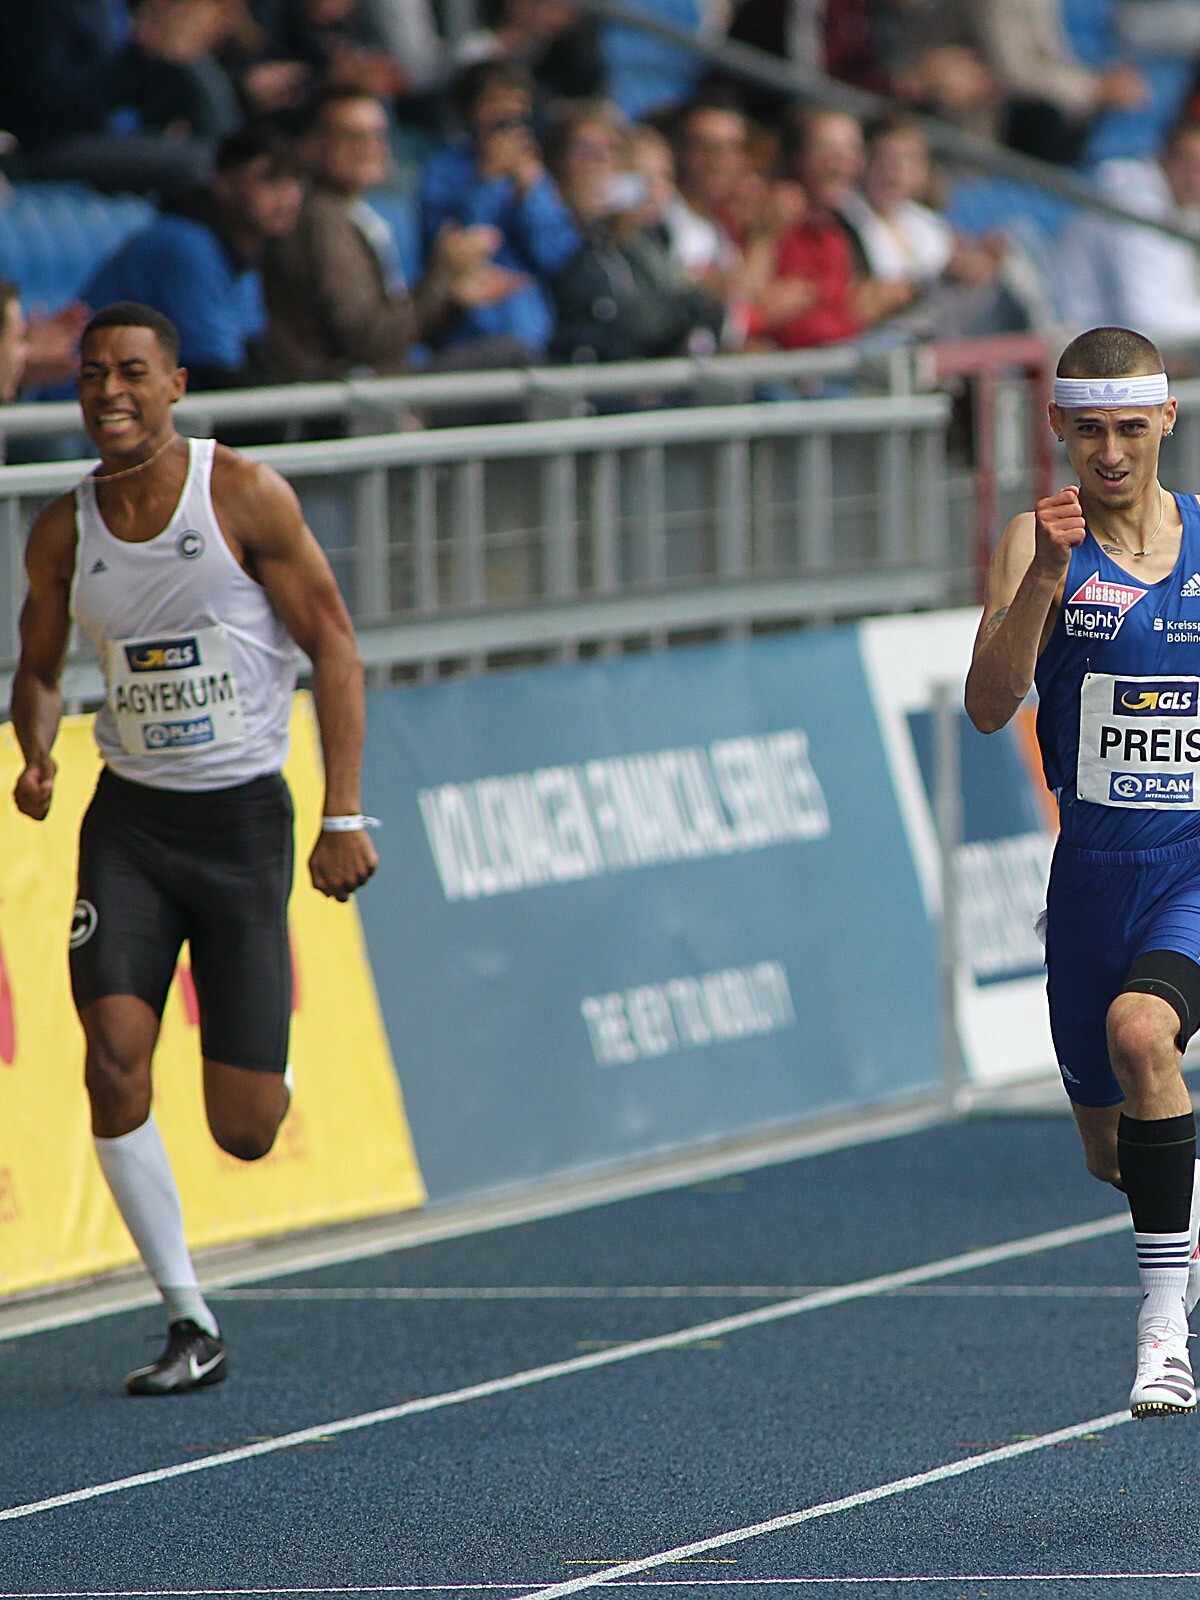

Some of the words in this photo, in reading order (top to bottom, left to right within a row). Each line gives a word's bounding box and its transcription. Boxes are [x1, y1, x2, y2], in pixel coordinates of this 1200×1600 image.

[1084, 584, 1134, 606] elsässer
[1064, 608, 1125, 641] Mighty
[164, 645, 194, 667] GLS
[116, 672, 234, 713] AGYEKUM
[1158, 692, 1192, 710] GLS
[1145, 778, 1191, 793] PLAN
